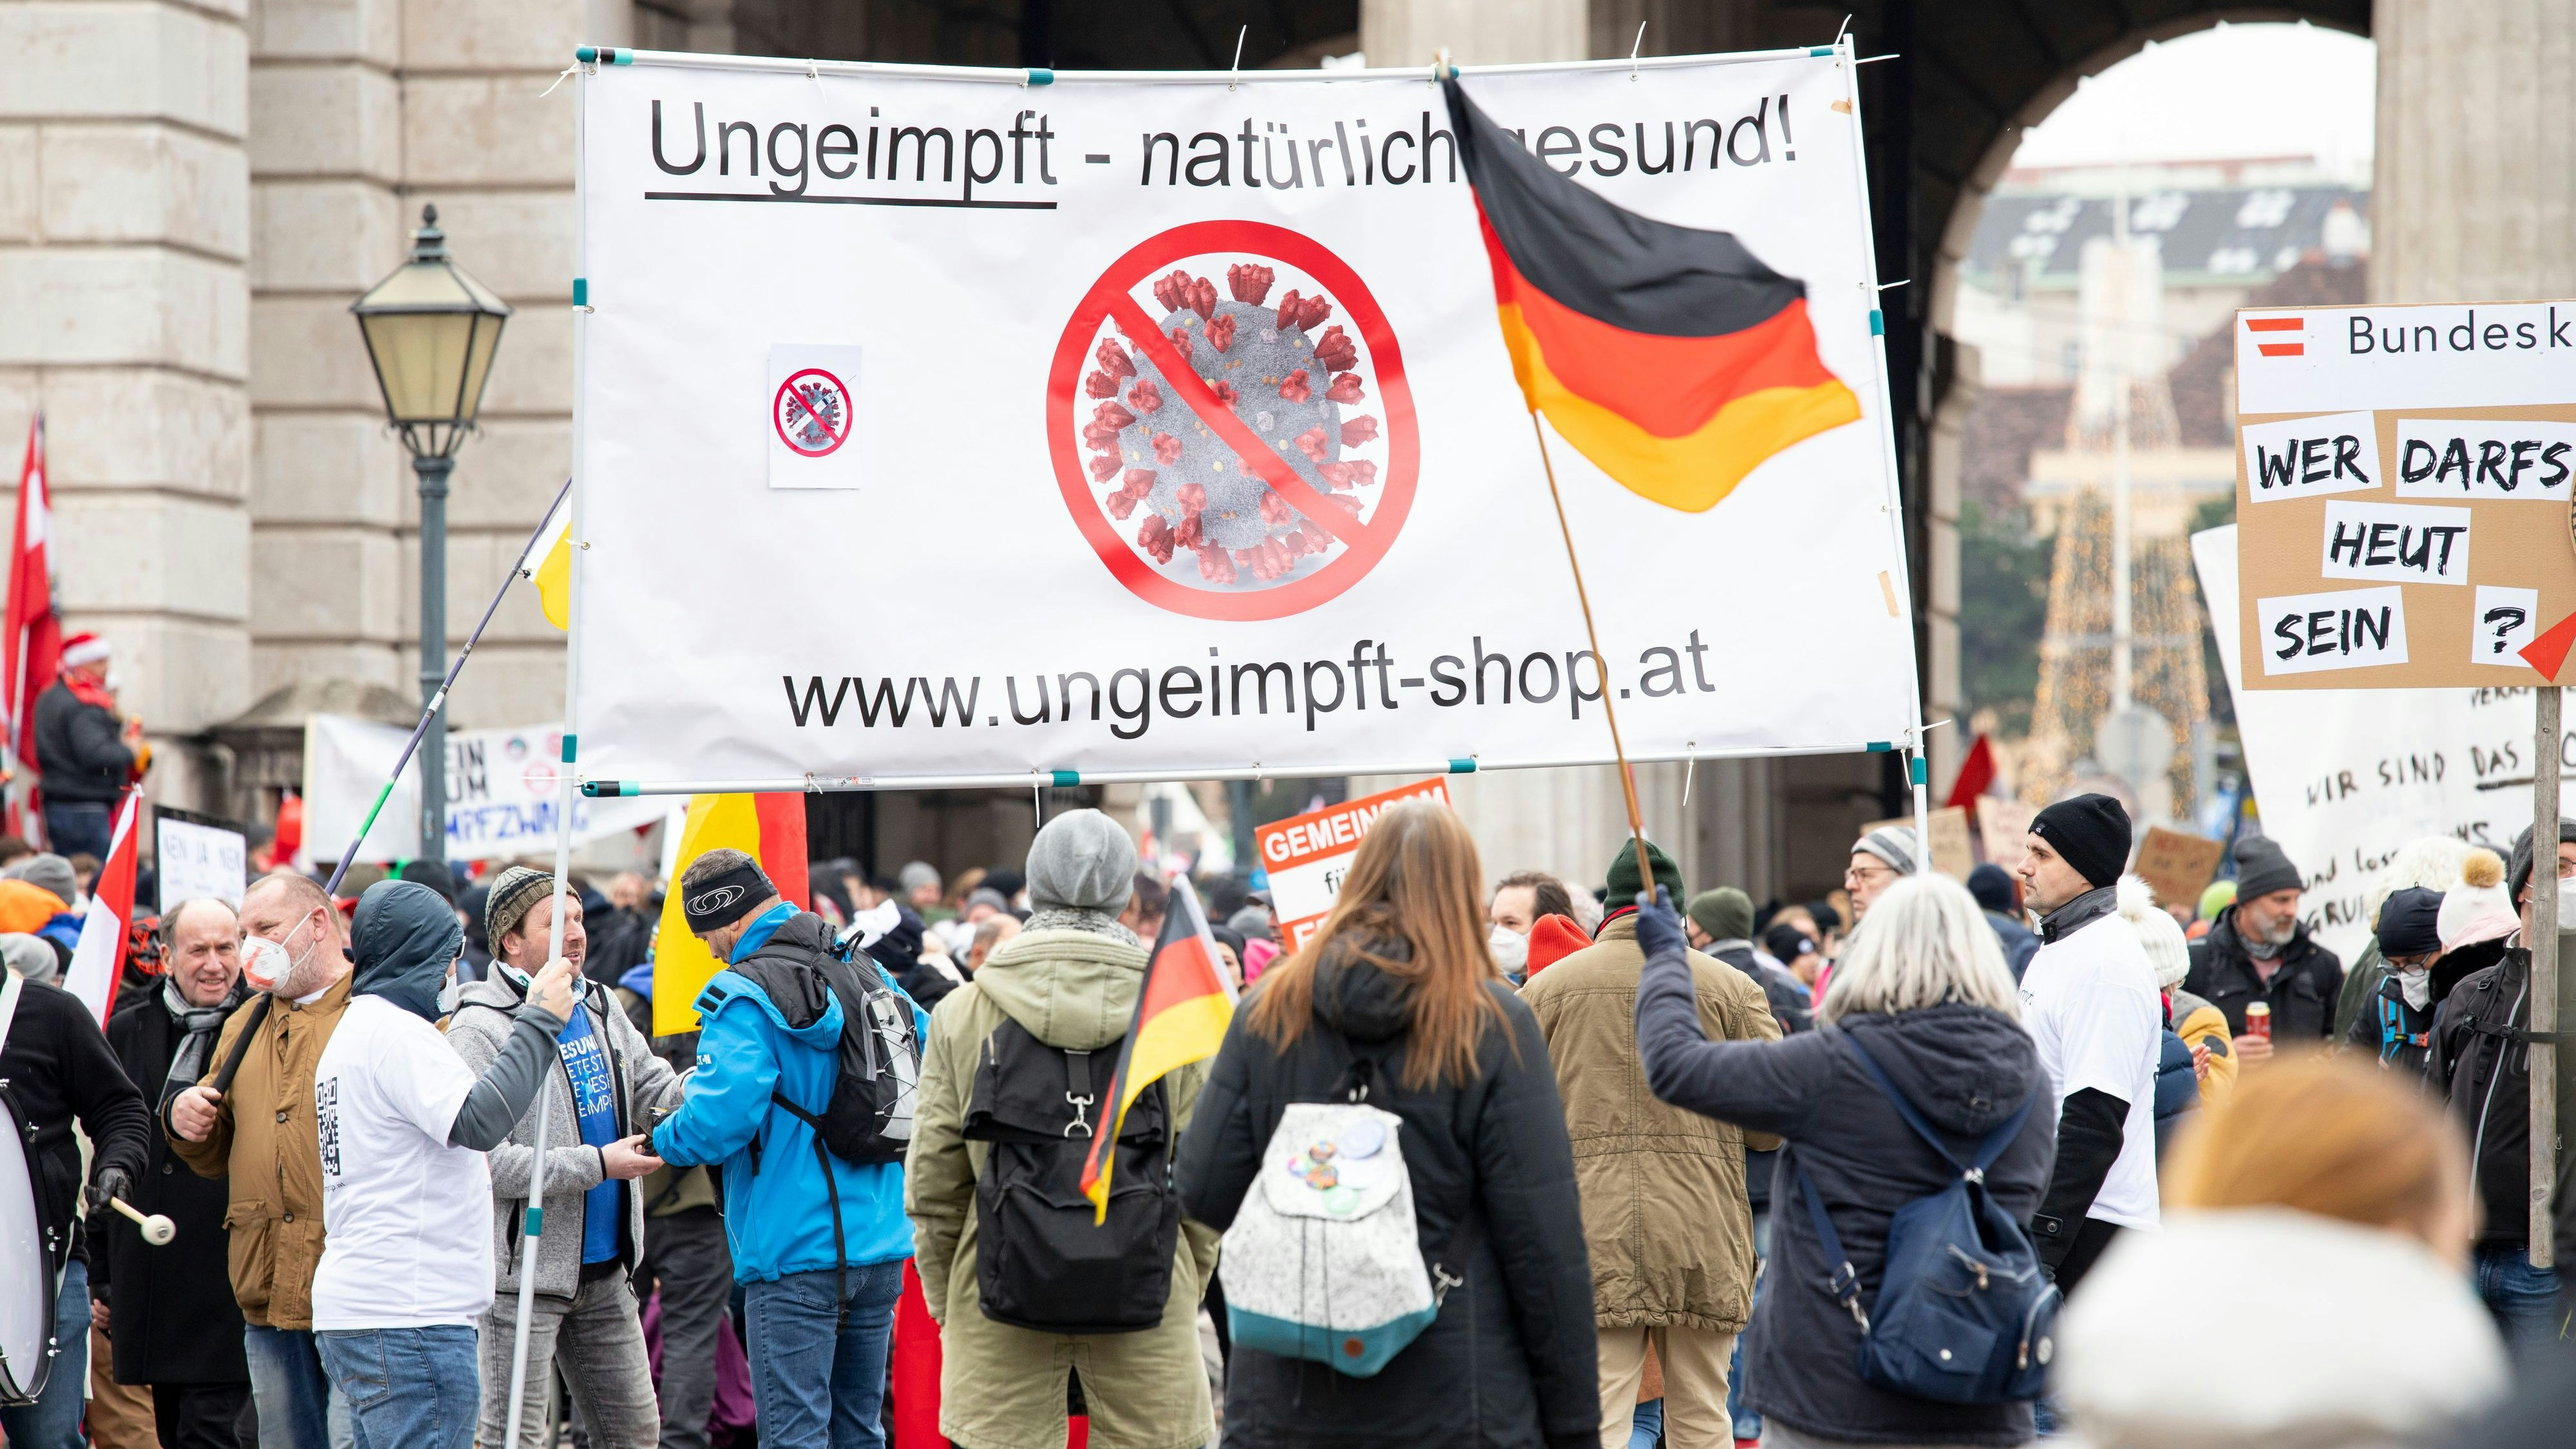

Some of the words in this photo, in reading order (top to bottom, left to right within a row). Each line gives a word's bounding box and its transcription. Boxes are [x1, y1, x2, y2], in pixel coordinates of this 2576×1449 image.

[652, 100, 1057, 201] Ungeimpft
[1085, 154, 1110, 164] -
[1141, 111, 1456, 190] natürlich
[1500, 94, 1795, 177] esund!
[2349, 307, 2573, 354] Bundesk
[2257, 435, 2370, 489] WER
[2401, 438, 2573, 491] DARFS
[2330, 521, 2467, 576] HEUT
[2274, 606, 2391, 661] SEIN
[2484, 607, 2525, 653] ?
[782, 629, 1716, 739] www.ungeimpft-shop.at
[2379, 751, 2445, 786] SIND
[2471, 741, 2518, 777] DAS
[444, 774, 490, 801] UM
[2306, 895, 2363, 933] GRU
[560, 1034, 598, 1060] ESUN
[566, 1054, 604, 1079] ETEST
